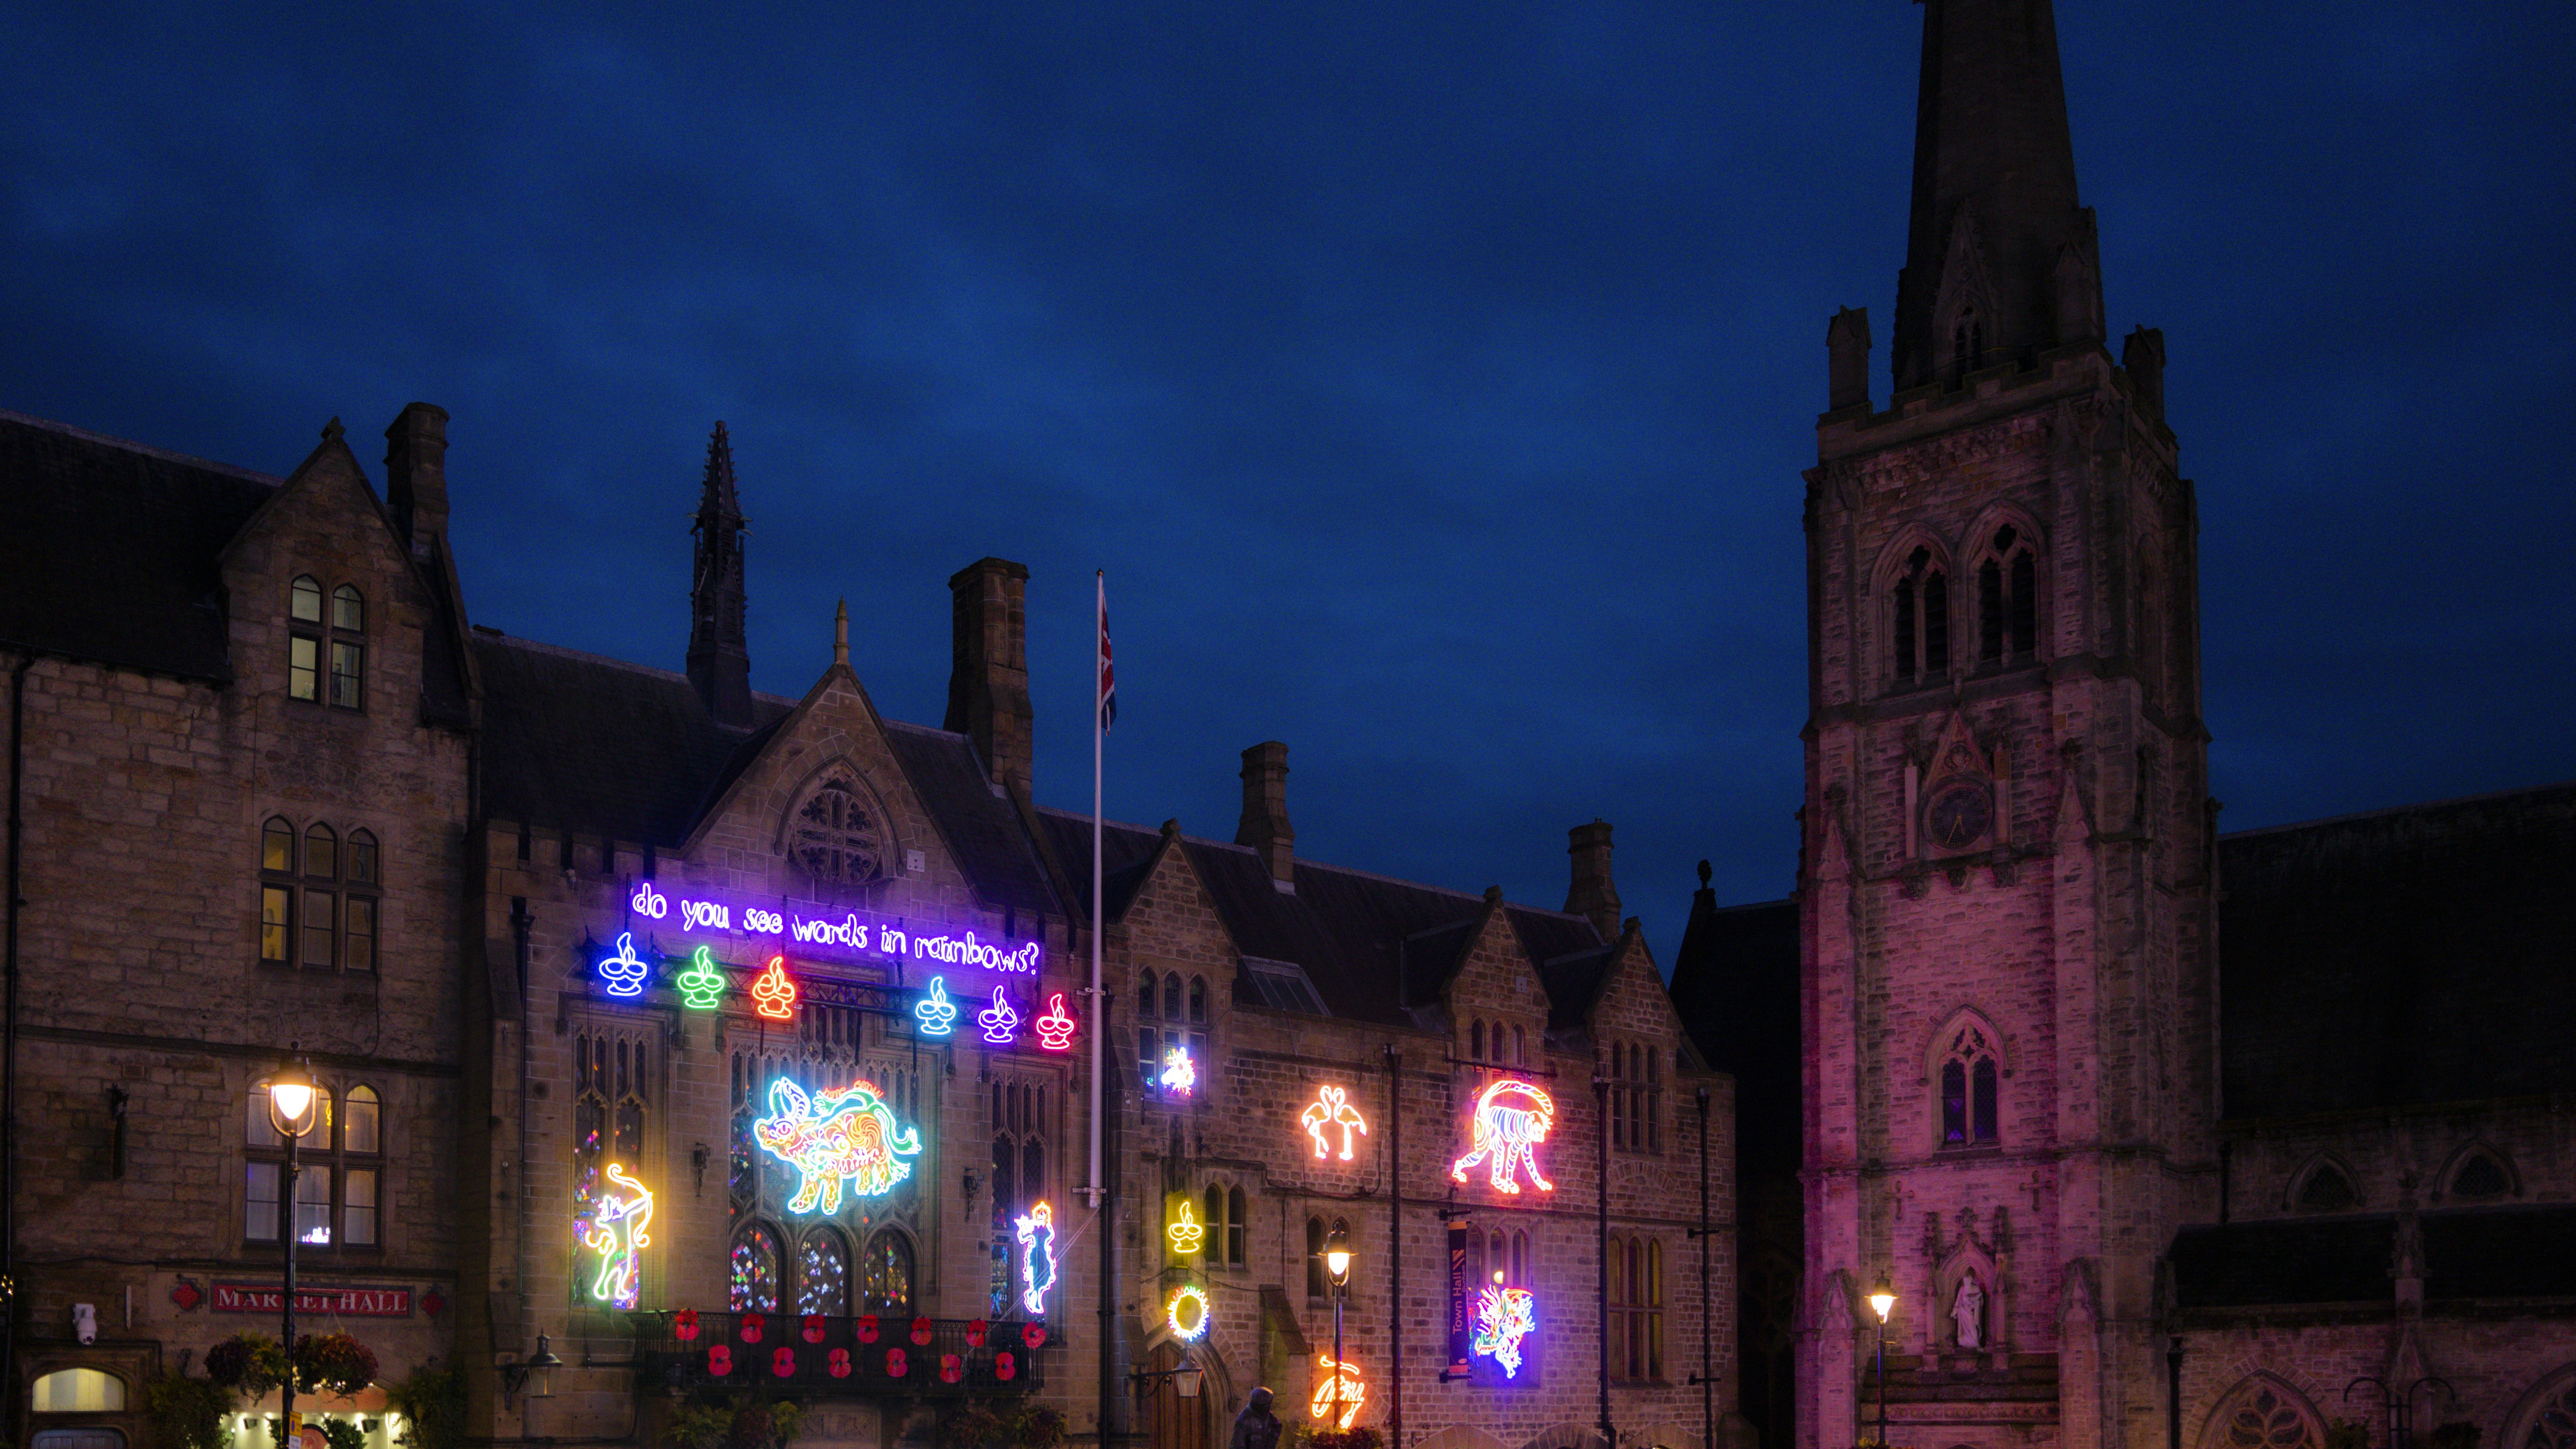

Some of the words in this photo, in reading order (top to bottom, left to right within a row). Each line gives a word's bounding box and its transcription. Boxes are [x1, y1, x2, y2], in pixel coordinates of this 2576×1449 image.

[632, 883, 667, 918] do
[681, 900, 730, 931] you
[744, 908, 783, 933] see
[792, 914, 868, 948] words
[881, 924, 906, 954] in
[915, 931, 1039, 975] rainbows?
[1453, 1272, 1462, 1296] Hall
[340, 1293, 407, 1312] HALL
[1453, 1301, 1462, 1334] Town
